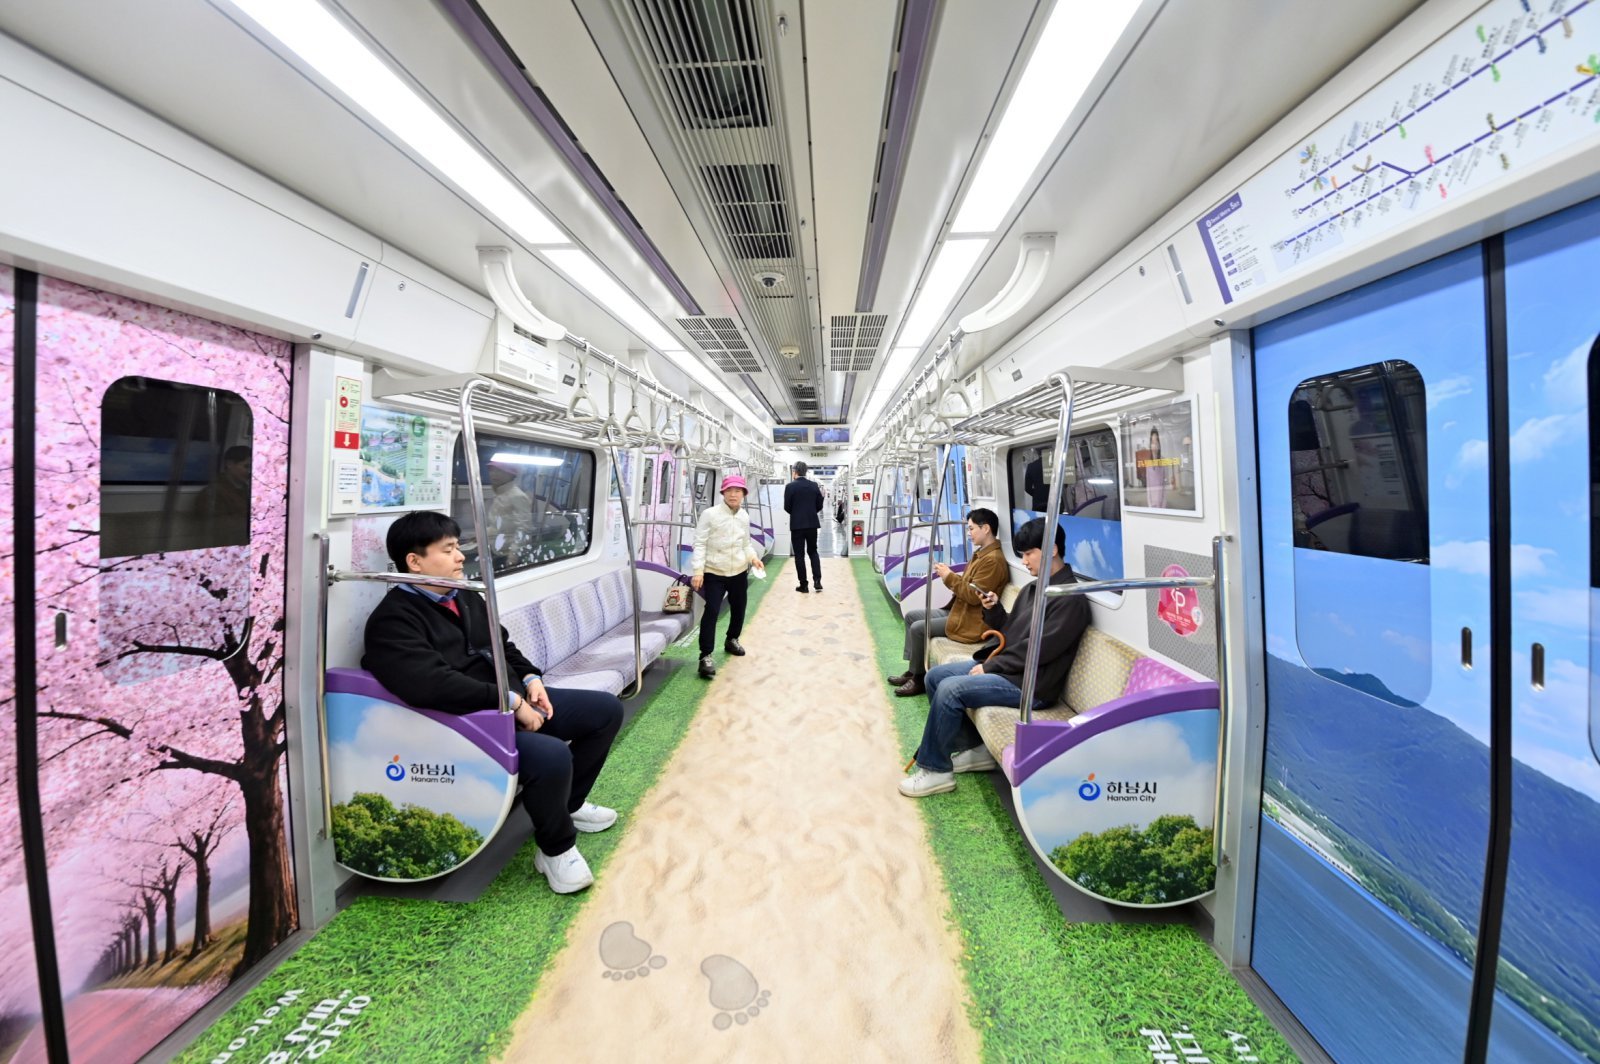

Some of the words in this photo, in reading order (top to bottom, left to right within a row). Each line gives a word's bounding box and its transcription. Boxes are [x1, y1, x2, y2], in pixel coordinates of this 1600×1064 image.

[410, 763, 454, 776] 하남시
[440, 776, 455, 784] City
[1107, 781, 1157, 794] 하남시
[1139, 795, 1156, 803] City
[1223, 1029, 1259, 1063] ity
